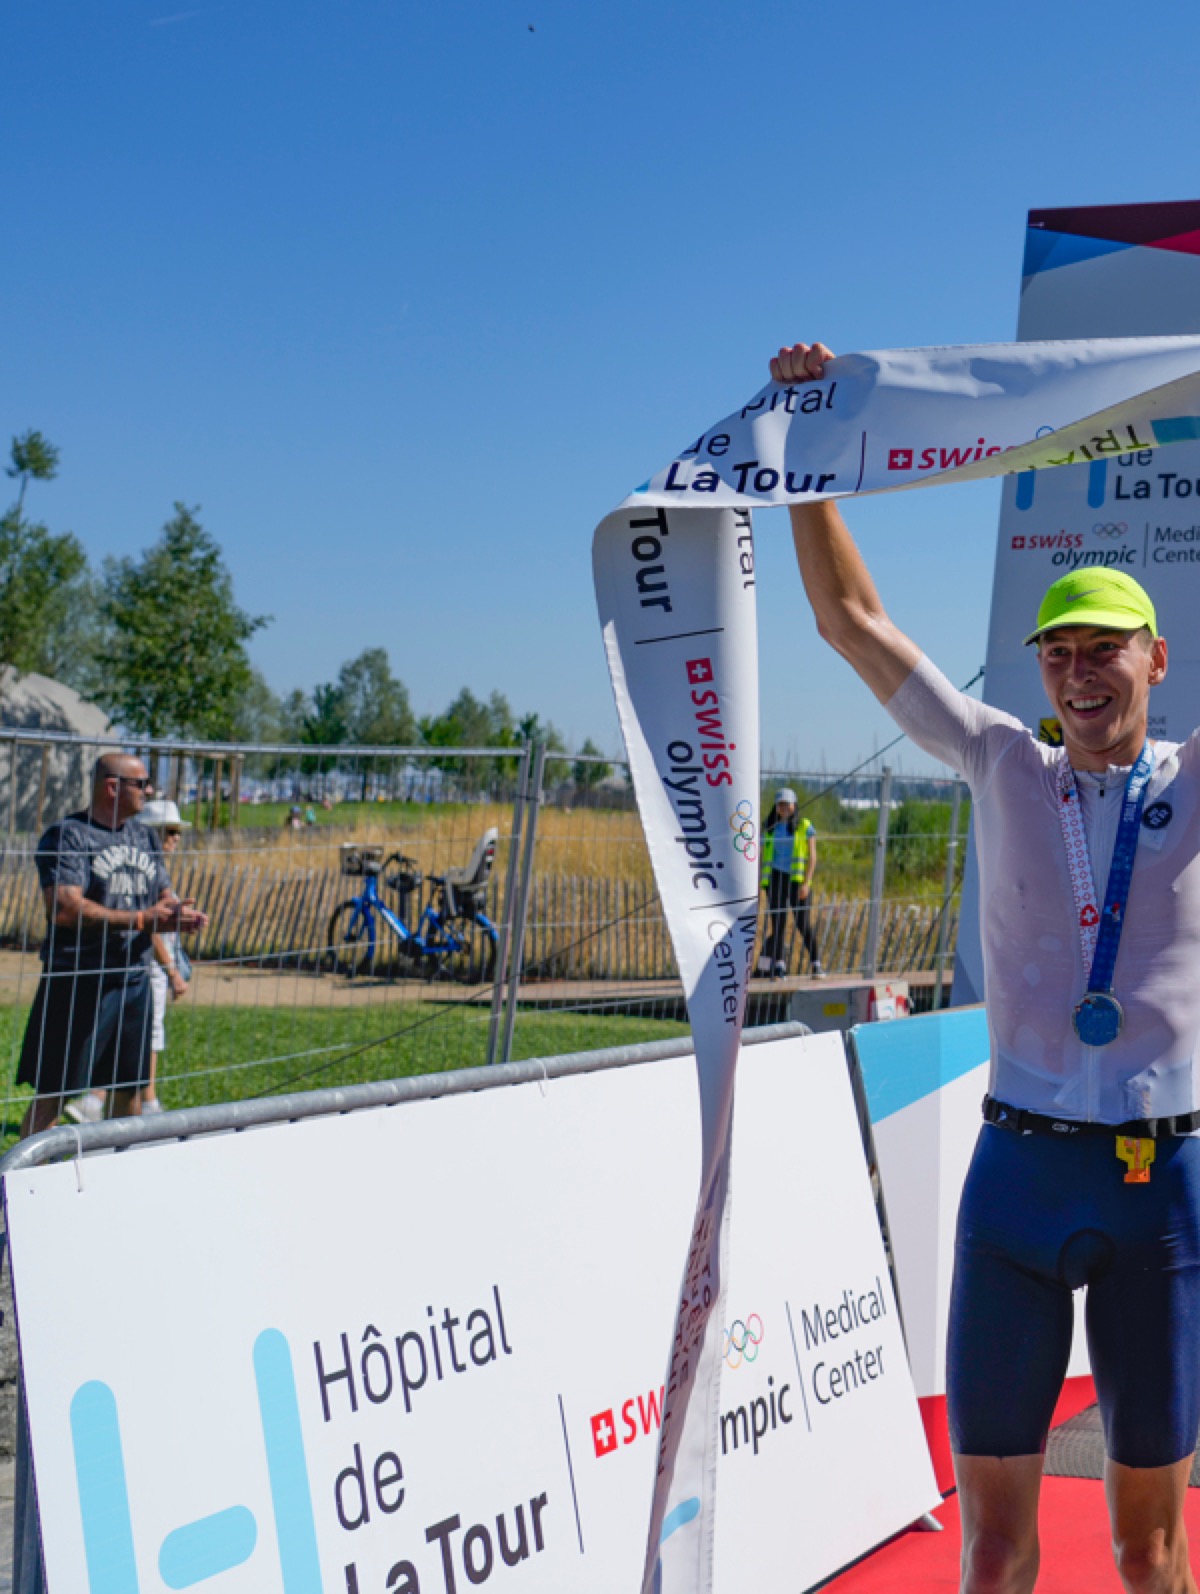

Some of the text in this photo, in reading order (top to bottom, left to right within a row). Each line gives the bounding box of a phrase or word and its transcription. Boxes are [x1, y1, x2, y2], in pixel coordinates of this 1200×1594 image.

[664, 461, 837, 494] La Tour
[1115, 475, 1151, 500] La
[629, 508, 673, 613] Tour
[1028, 529, 1085, 549] swiss
[1051, 545, 1137, 568] olympic
[690, 689, 734, 787] swiss
[662, 740, 724, 889] olympic
[708, 920, 741, 1026] Center
[313, 1284, 513, 1423] Hôpital
[801, 1275, 887, 1351] Medical
[812, 1345, 885, 1404] Center
[334, 1442, 405, 1531] de
[425, 1491, 548, 1594] Tour
